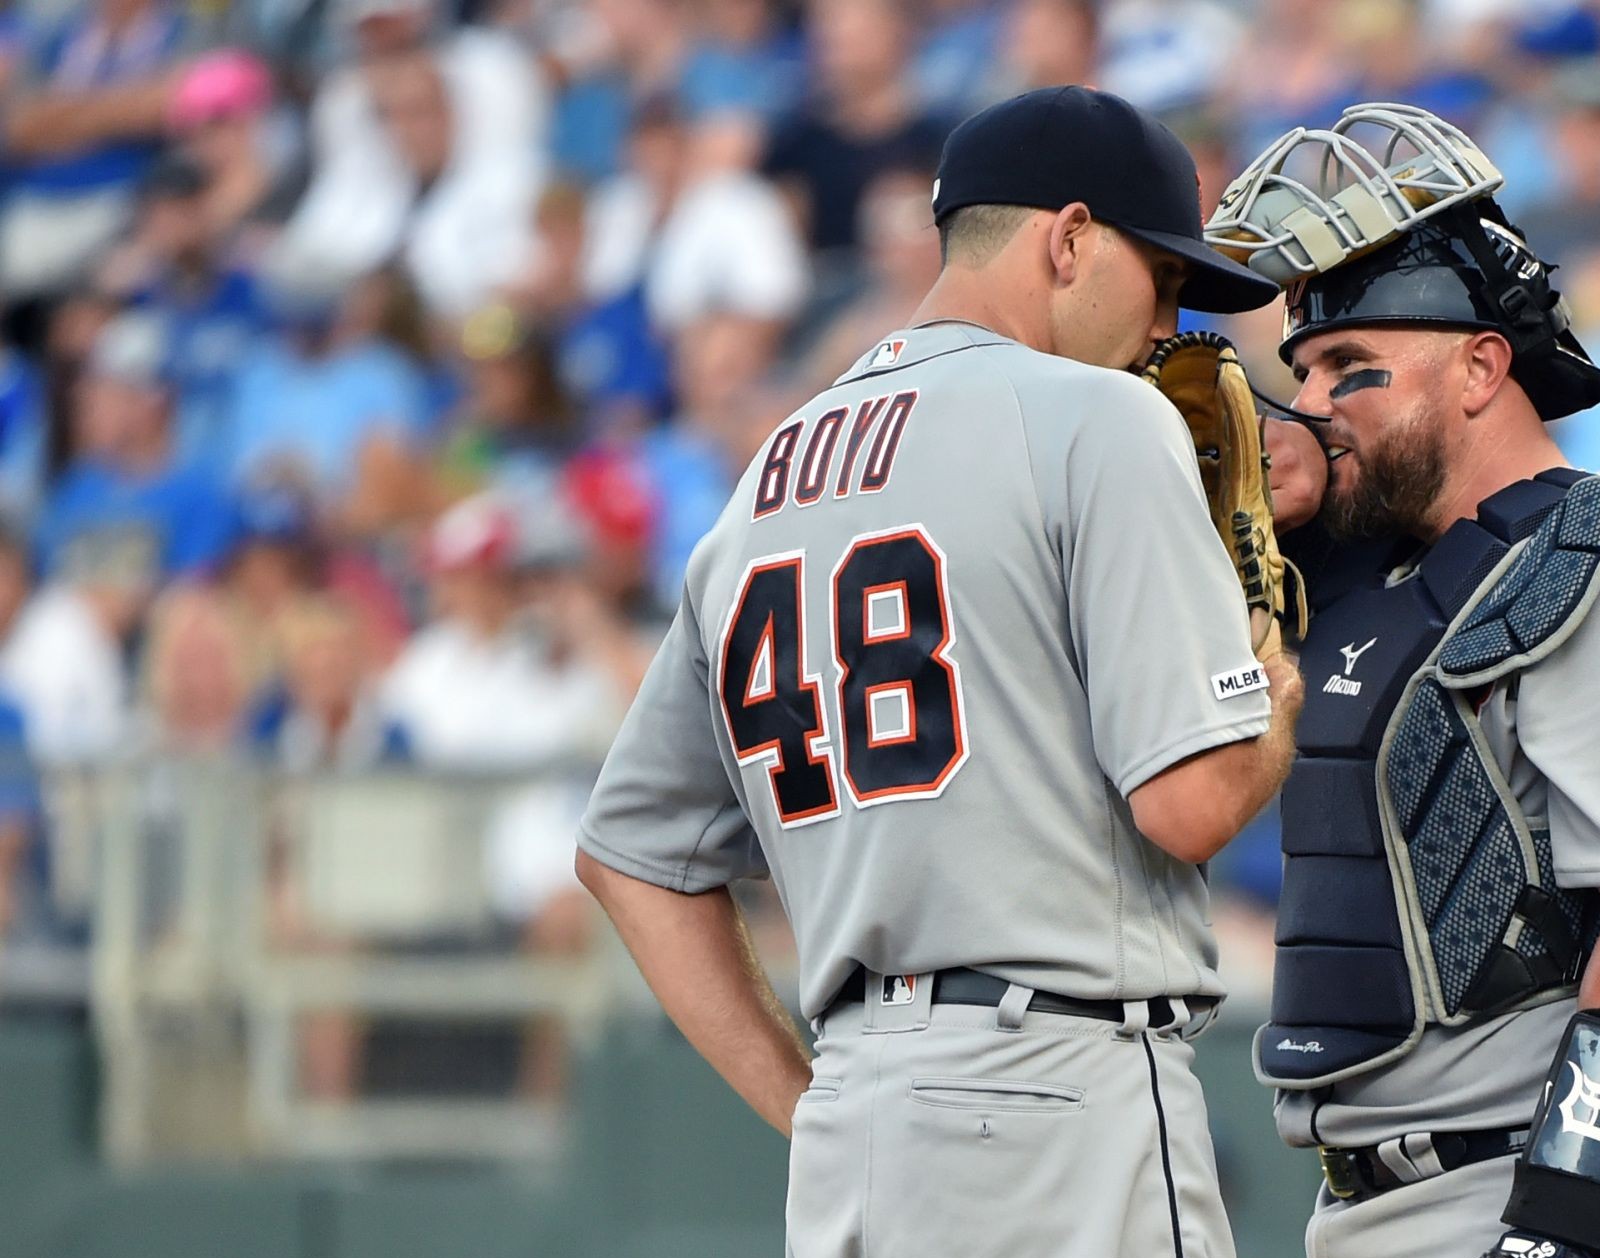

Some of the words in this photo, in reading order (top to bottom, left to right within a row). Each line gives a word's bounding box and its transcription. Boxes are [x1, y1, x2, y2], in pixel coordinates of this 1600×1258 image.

[751, 388, 920, 523] BOYD
[717, 522, 971, 830] 48
[1219, 671, 1253, 694] MLB
